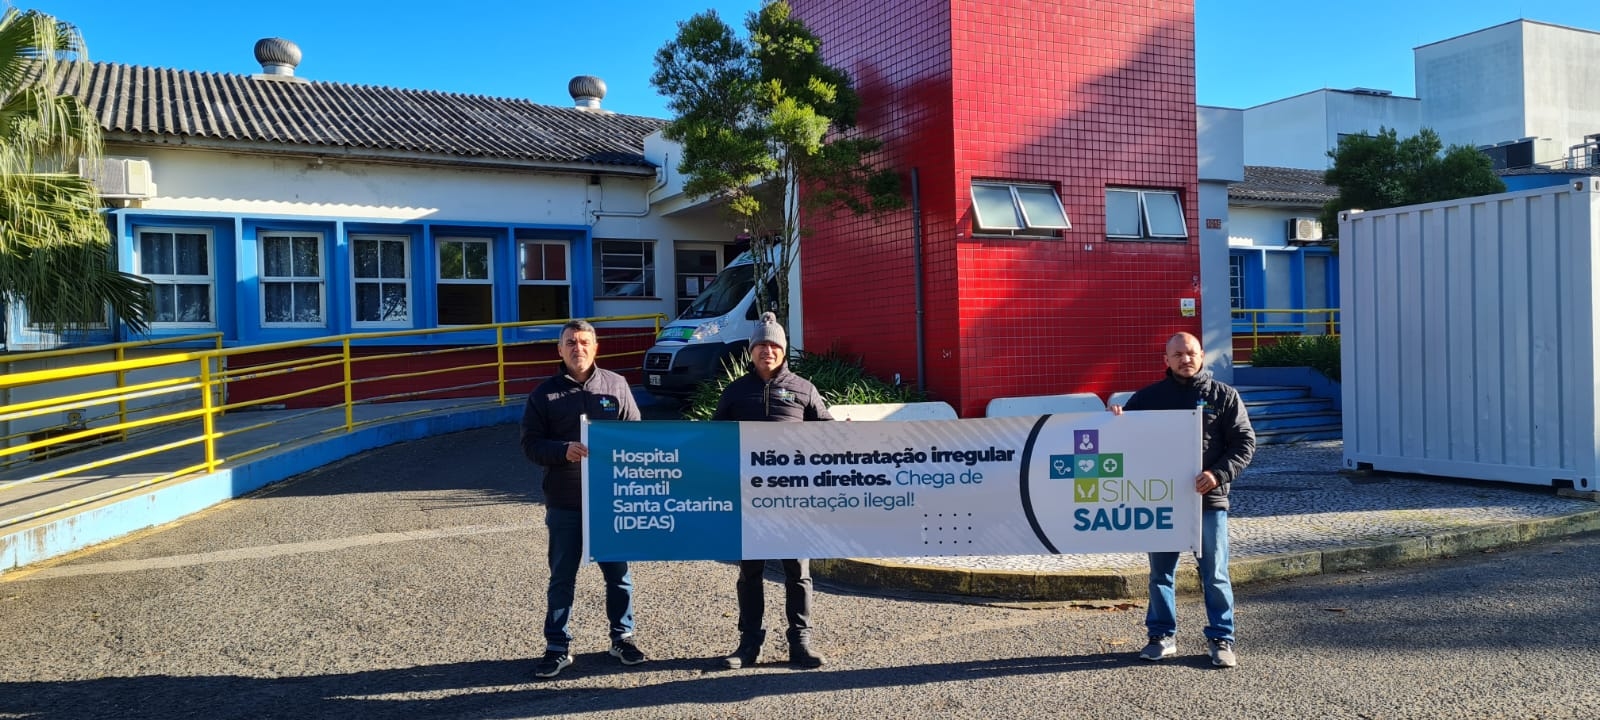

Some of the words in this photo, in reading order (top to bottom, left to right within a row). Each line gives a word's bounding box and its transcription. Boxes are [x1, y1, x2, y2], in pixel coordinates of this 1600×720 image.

[612, 448, 679, 466] Hospital
[751, 450, 790, 466] Não
[793, 450, 806, 466] à
[809, 449, 928, 468] contratação
[931, 446, 1015, 466] irregular
[613, 466, 683, 479] Materno
[750, 476, 763, 488] e
[767, 475, 809, 487] sem
[813, 469, 892, 487] direitos.
[895, 470, 955, 488] Chega
[959, 469, 983, 484] de
[613, 481, 670, 496] Infantil
[1102, 478, 1174, 502] SINDI
[613, 499, 660, 513] Santa
[664, 497, 733, 512] Catarina
[751, 493, 860, 512] contratação
[864, 491, 914, 510] ilegal!
[613, 515, 675, 533] (IDEAS)
[1073, 503, 1174, 531] SAÚDE
